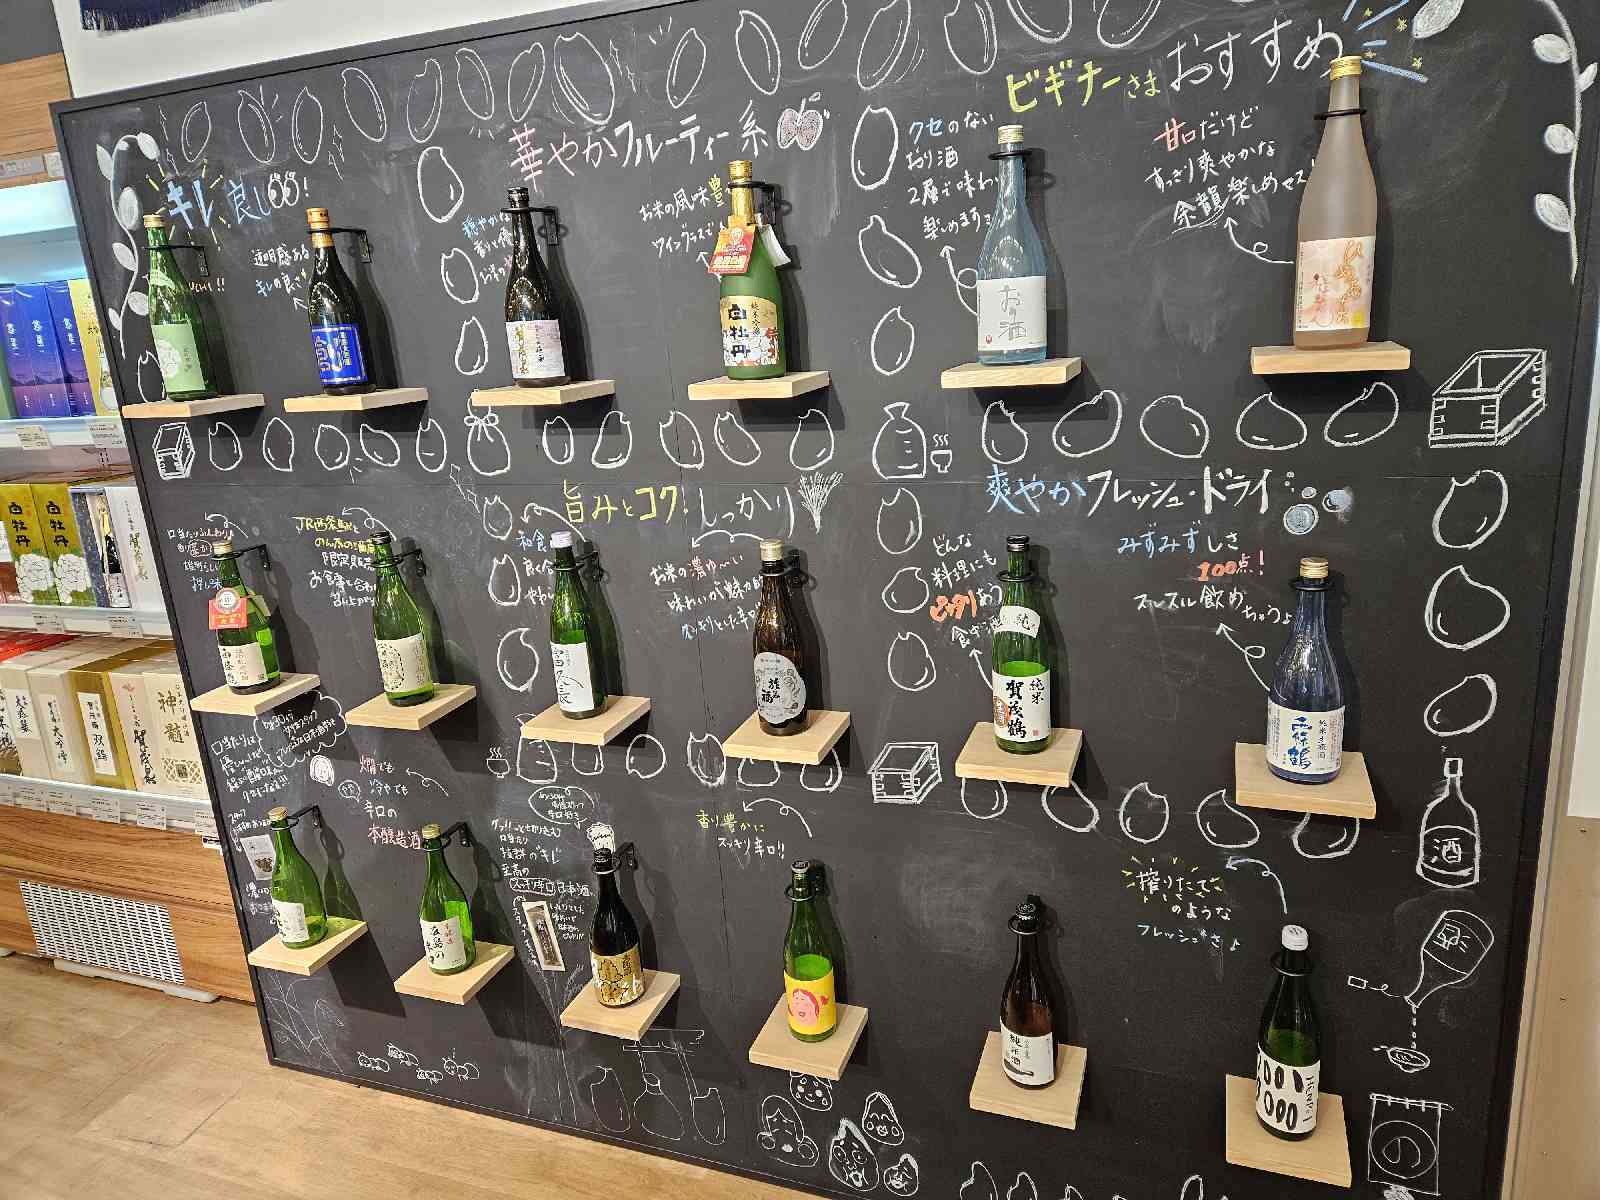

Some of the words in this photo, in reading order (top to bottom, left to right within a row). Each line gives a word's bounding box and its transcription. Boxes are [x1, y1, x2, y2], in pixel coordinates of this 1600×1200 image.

[509, 100, 768, 192] 華やかフルーティー系
[1153, 106, 1260, 152] 甘口だけど
[639, 173, 732, 222] お米の風味豊
[699, 486, 796, 538] しっかり
[1006, 680, 1027, 739] 賀茂鶴
[1029, 677, 1045, 705] 純米
[1432, 838, 1462, 864] 酒
